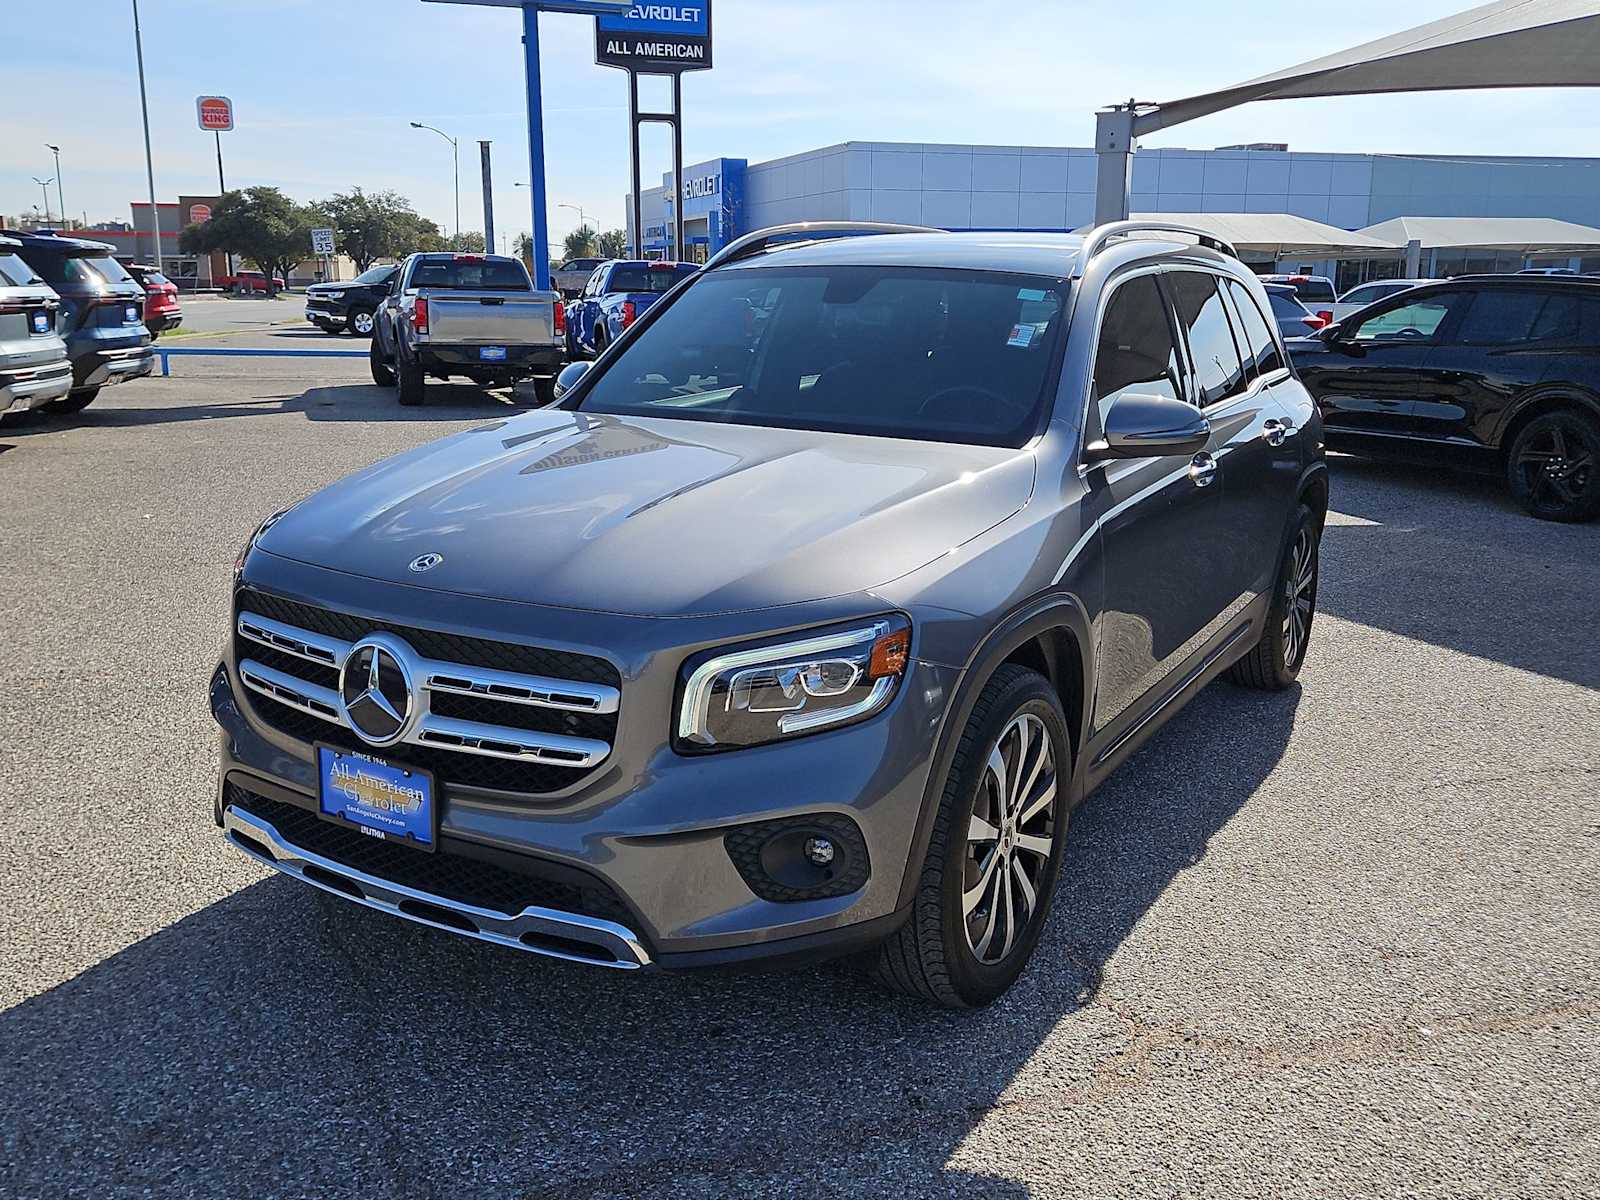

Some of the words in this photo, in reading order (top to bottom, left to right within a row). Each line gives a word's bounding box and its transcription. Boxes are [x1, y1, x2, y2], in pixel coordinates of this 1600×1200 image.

[624, 4, 701, 22] EVROLET
[606, 40, 631, 55] ALL
[635, 41, 703, 59] AMERICAN
[202, 114, 229, 123] KING
[681, 174, 720, 200] HEVROLET
[316, 242, 333, 252] 35
[351, 751, 372, 763] SINCE
[329, 761, 349, 780] All
[354, 770, 425, 802] American
[345, 804, 406, 827] SanAngeloChevy.com
